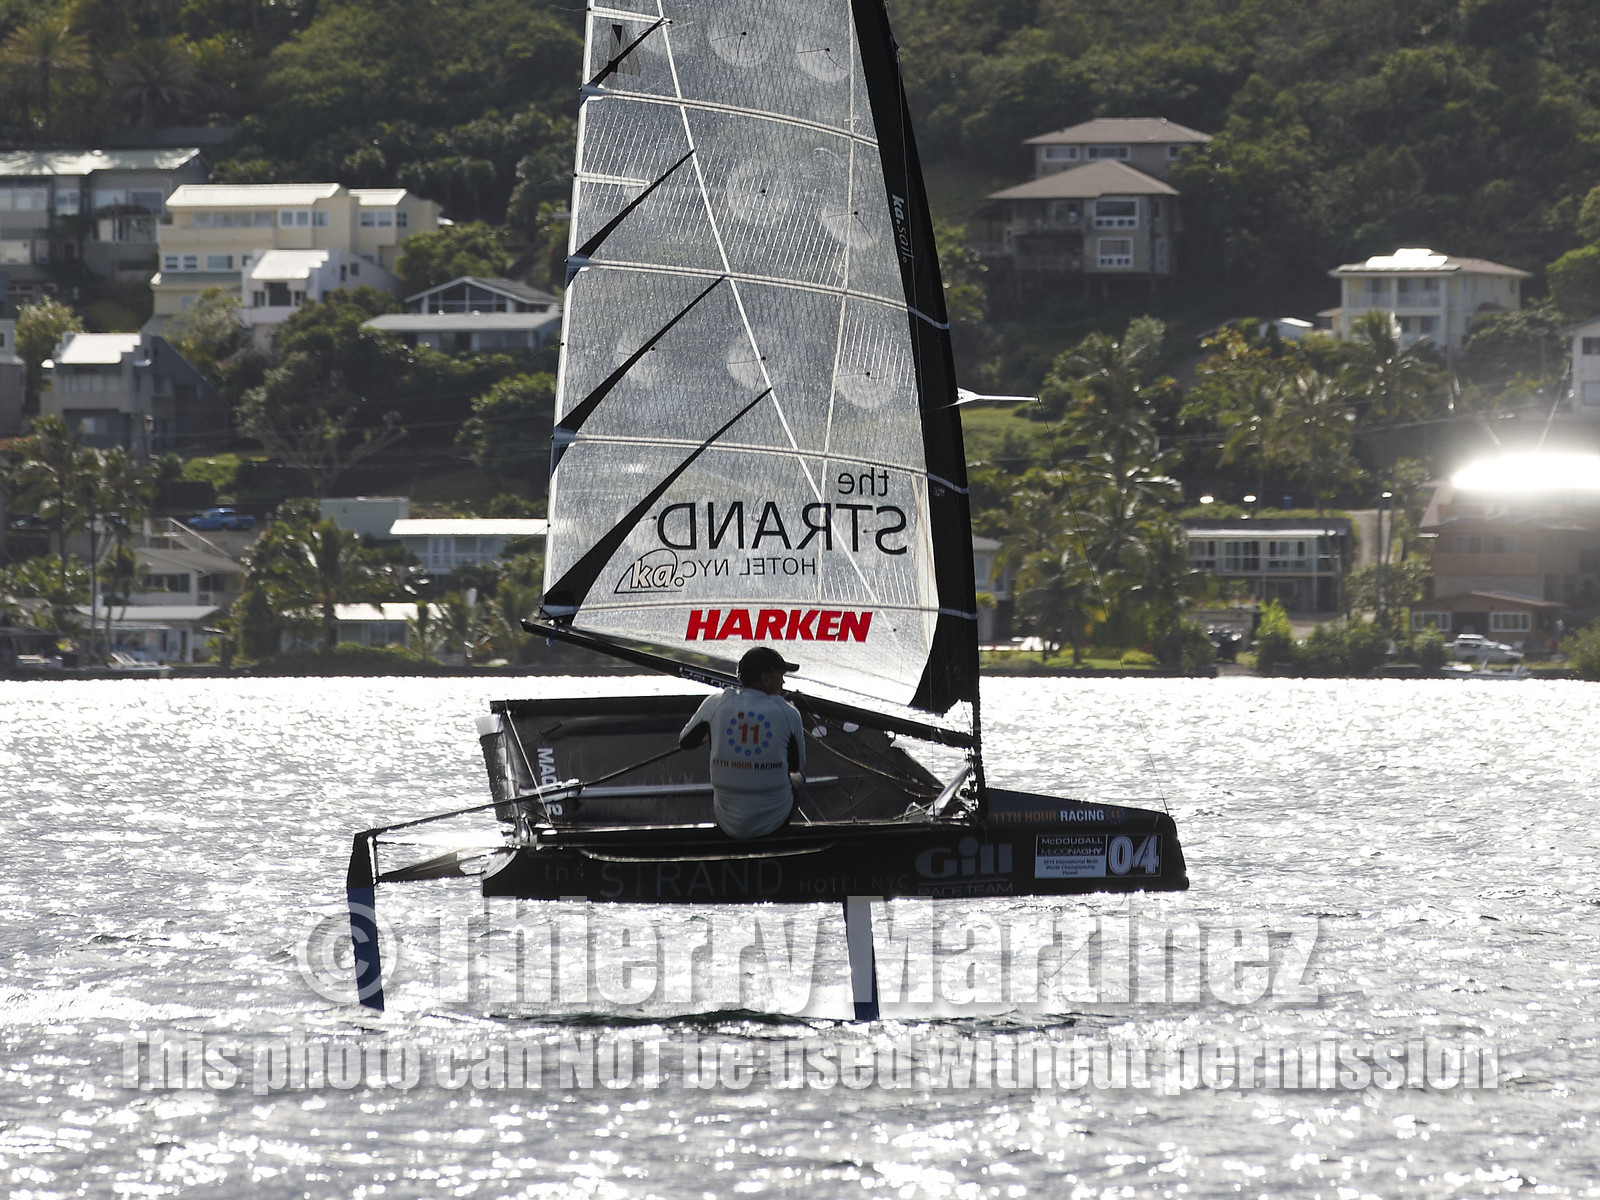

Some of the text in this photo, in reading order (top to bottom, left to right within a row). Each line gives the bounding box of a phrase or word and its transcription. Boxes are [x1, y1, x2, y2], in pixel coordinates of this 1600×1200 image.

[685, 609, 873, 643] HARKEN
[739, 723, 760, 745] 11
[732, 760, 752, 770] HOUR
[993, 809, 1105, 825] 11TH HOUR RACING
[915, 836, 1013, 879] Gill
[1108, 835, 1160, 876] 04
[601, 858, 783, 897] STRAND
[801, 876, 864, 893] HOTEL
